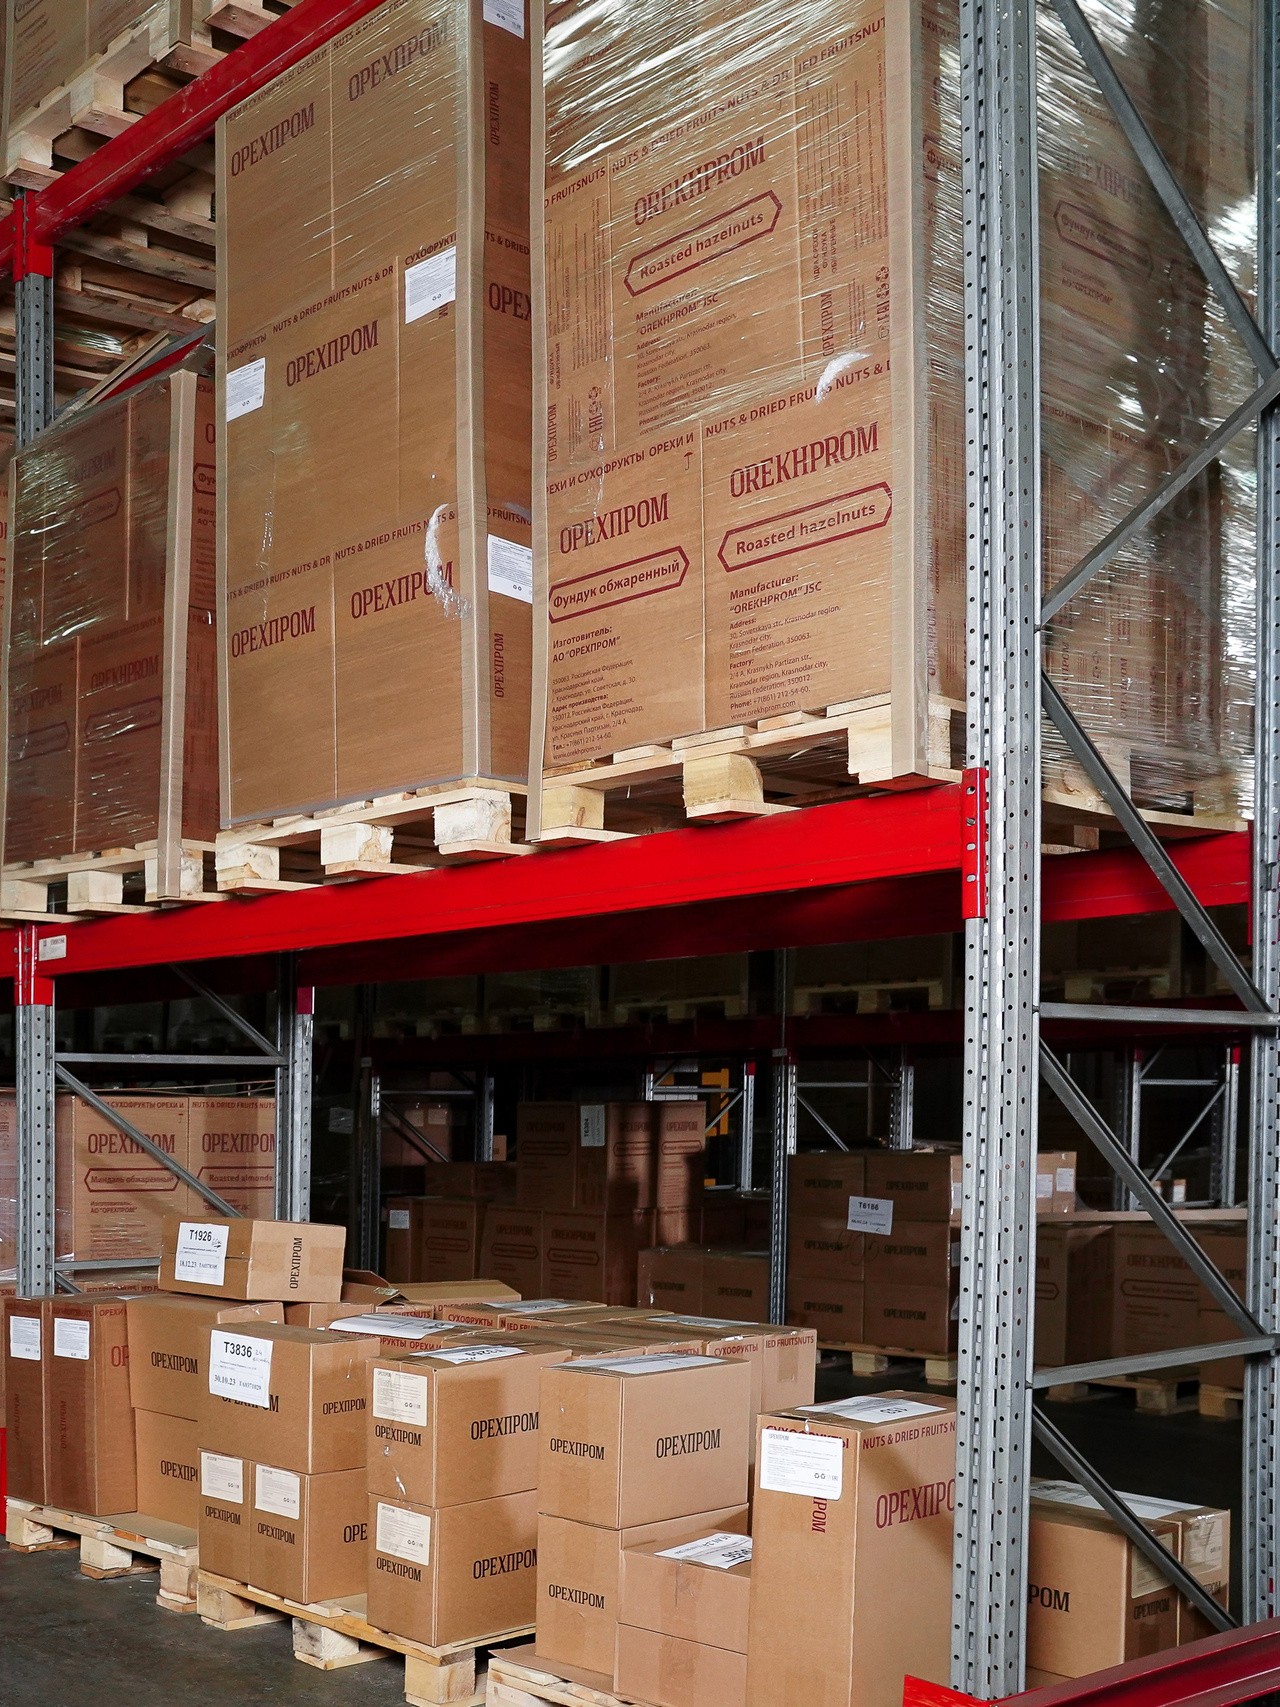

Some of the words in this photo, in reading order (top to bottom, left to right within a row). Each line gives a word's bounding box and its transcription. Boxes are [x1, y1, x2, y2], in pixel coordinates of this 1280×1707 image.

[348, 16, 449, 101] ОРЕХПРОМ
[489, 81, 500, 146] ОРЕХПРОМ
[231, 102, 316, 177] ОРЕХПРОМ
[612, 149, 640, 173] NUTS
[551, 166, 606, 207] FRUITSNUTS
[634, 134, 767, 227] OREKHPROM
[505, 238, 530, 255] DRIED
[639, 241, 694, 280] Roasted
[695, 211, 765, 255] hazelnuts
[272, 316, 293, 335] NUTS
[299, 302, 323, 320] DRIED
[324, 286, 351, 306] FRUITS
[351, 275, 373, 294] NUTS
[821, 290, 834, 357] ОРЕХПРОМ
[286, 319, 379, 387] ОРЕХПРОМ
[637, 375, 662, 389] Factory:
[706, 419, 737, 438] NUTS
[738, 412, 748, 425] &
[749, 398, 787, 421] DRIED
[836, 371, 871, 392] NUTS
[873, 363, 883, 376] &
[547, 404, 558, 462] ОРЕХПРОМ
[578, 450, 646, 485] СУХОФРУКТЫ
[648, 435, 684, 456] ОРЕХИ
[685, 431, 695, 444] И
[730, 421, 880, 498] OREKHPROM
[559, 492, 669, 554] ОРЕХПРОМ
[735, 525, 796, 556] Roasted
[798, 502, 877, 538] hazelnuts
[335, 544, 356, 561] NUTS
[365, 532, 390, 549] DRIED
[392, 522, 422, 540] FRUITS
[423, 512, 447, 531] NTS
[291, 561, 312, 577] NUTS
[553, 582, 597, 610] Фундук
[598, 557, 681, 593] обжаренный
[729, 573, 800, 601] Manufacturer:
[803, 580, 822, 596] JSC
[231, 606, 316, 658] ОРЕХПРОМ
[729, 617, 757, 631] Address:
[738, 623, 772, 638] Sovetskaya
[784, 611, 817, 626] Krasnodar
[552, 625, 614, 650] Изготовитель:
[729, 636, 759, 650] Krasnodar
[493, 632, 505, 698] ОРЕХПРОМ
[552, 653, 565, 664] АО
[729, 658, 755, 670] Factory:
[746, 663, 774, 676] Krasnykh
[774, 656, 800, 668] Partizan
[729, 676, 759, 690] Krasnodar
[781, 663, 814, 677] Krasnodar
[729, 688, 752, 701] Russian
[752, 680, 787, 695] Federation,
[730, 700, 753, 711] Phone:
[730, 699, 797, 721] www.orekhprom.com
[208, 1173, 240, 1183] Roasted
[240, 1173, 273, 1183] almonds
[189, 1229, 212, 1242] T1926
[289, 1237, 303, 1290] ОРЕХПРОМ
[447, 1313, 493, 1328] СУХОФРУКТЫ
[223, 1341, 253, 1359] T3836
[409, 1341, 435, 1351] ОРЕХИ
[713, 1343, 759, 1357] СУХОФРУКТЫ
[776, 1335, 815, 1347] FRUITSNUTS
[151, 1351, 199, 1375] ОРЕХПРОМ
[213, 1374, 236, 1386] 30.10.23
[322, 1398, 367, 1416] ОРЕХПРОМ
[375, 1424, 422, 1447] ОРЕХПРОМ
[471, 1411, 540, 1441] ОРЕХПРОМ
[862, 1436, 886, 1450] NUTS
[887, 1433, 894, 1445] &
[894, 1429, 920, 1444] DRIED
[921, 1422, 946, 1438] FRUITS
[549, 1436, 606, 1462] ОРЕХПРОМ
[655, 1428, 721, 1460] ОРЕХПРОМ
[205, 1505, 241, 1526] ОРЕХПРОМ
[257, 1522, 296, 1545] ОРЕХПРОМ
[376, 1556, 422, 1582] ОРЕХПРОМ
[548, 1583, 606, 1610] ОРЕХПРОМ
